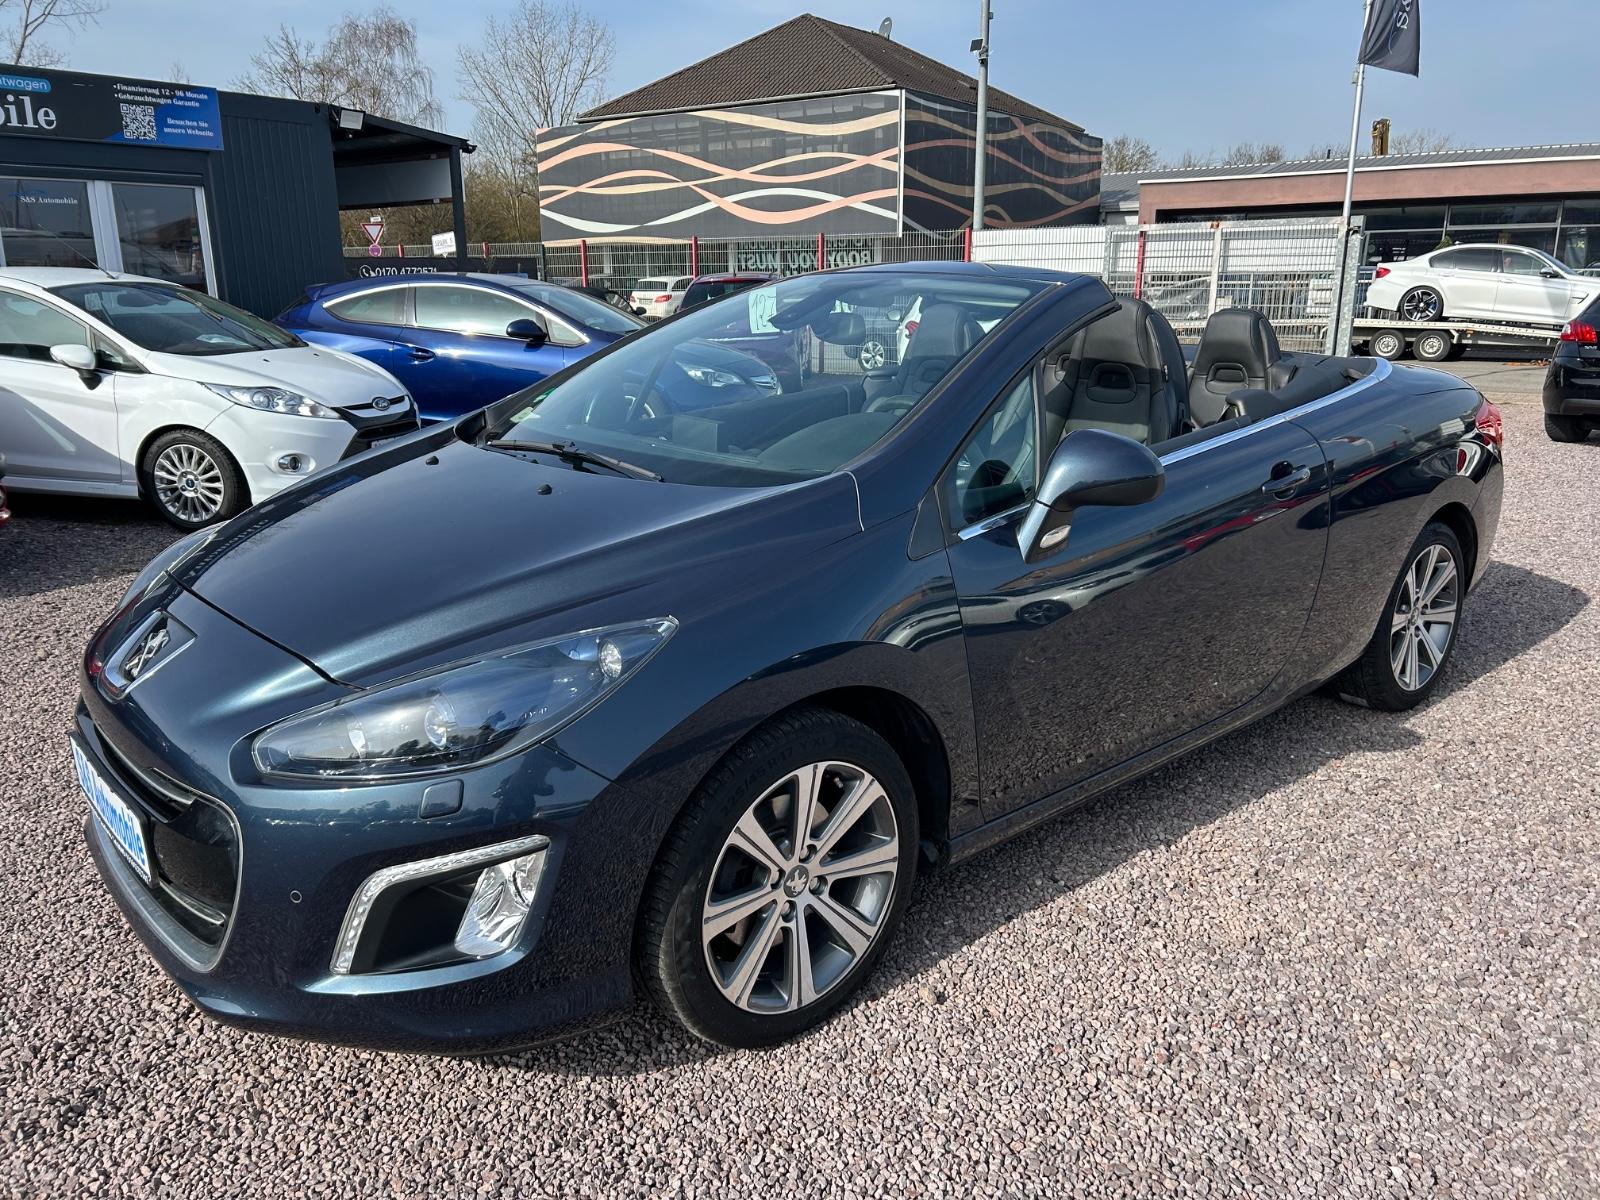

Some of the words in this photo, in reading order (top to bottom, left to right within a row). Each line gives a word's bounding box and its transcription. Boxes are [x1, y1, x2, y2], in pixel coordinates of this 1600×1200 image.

[0, 77, 47, 90] twagen
[118, 93, 172, 104] Gebrauchtwagen
[173, 98, 199, 107] Garantie
[186, 91, 208, 99] Monate
[167, 117, 197, 128] Besuchen
[187, 129, 214, 137] Webseite
[375, 267, 397, 277] 0170
